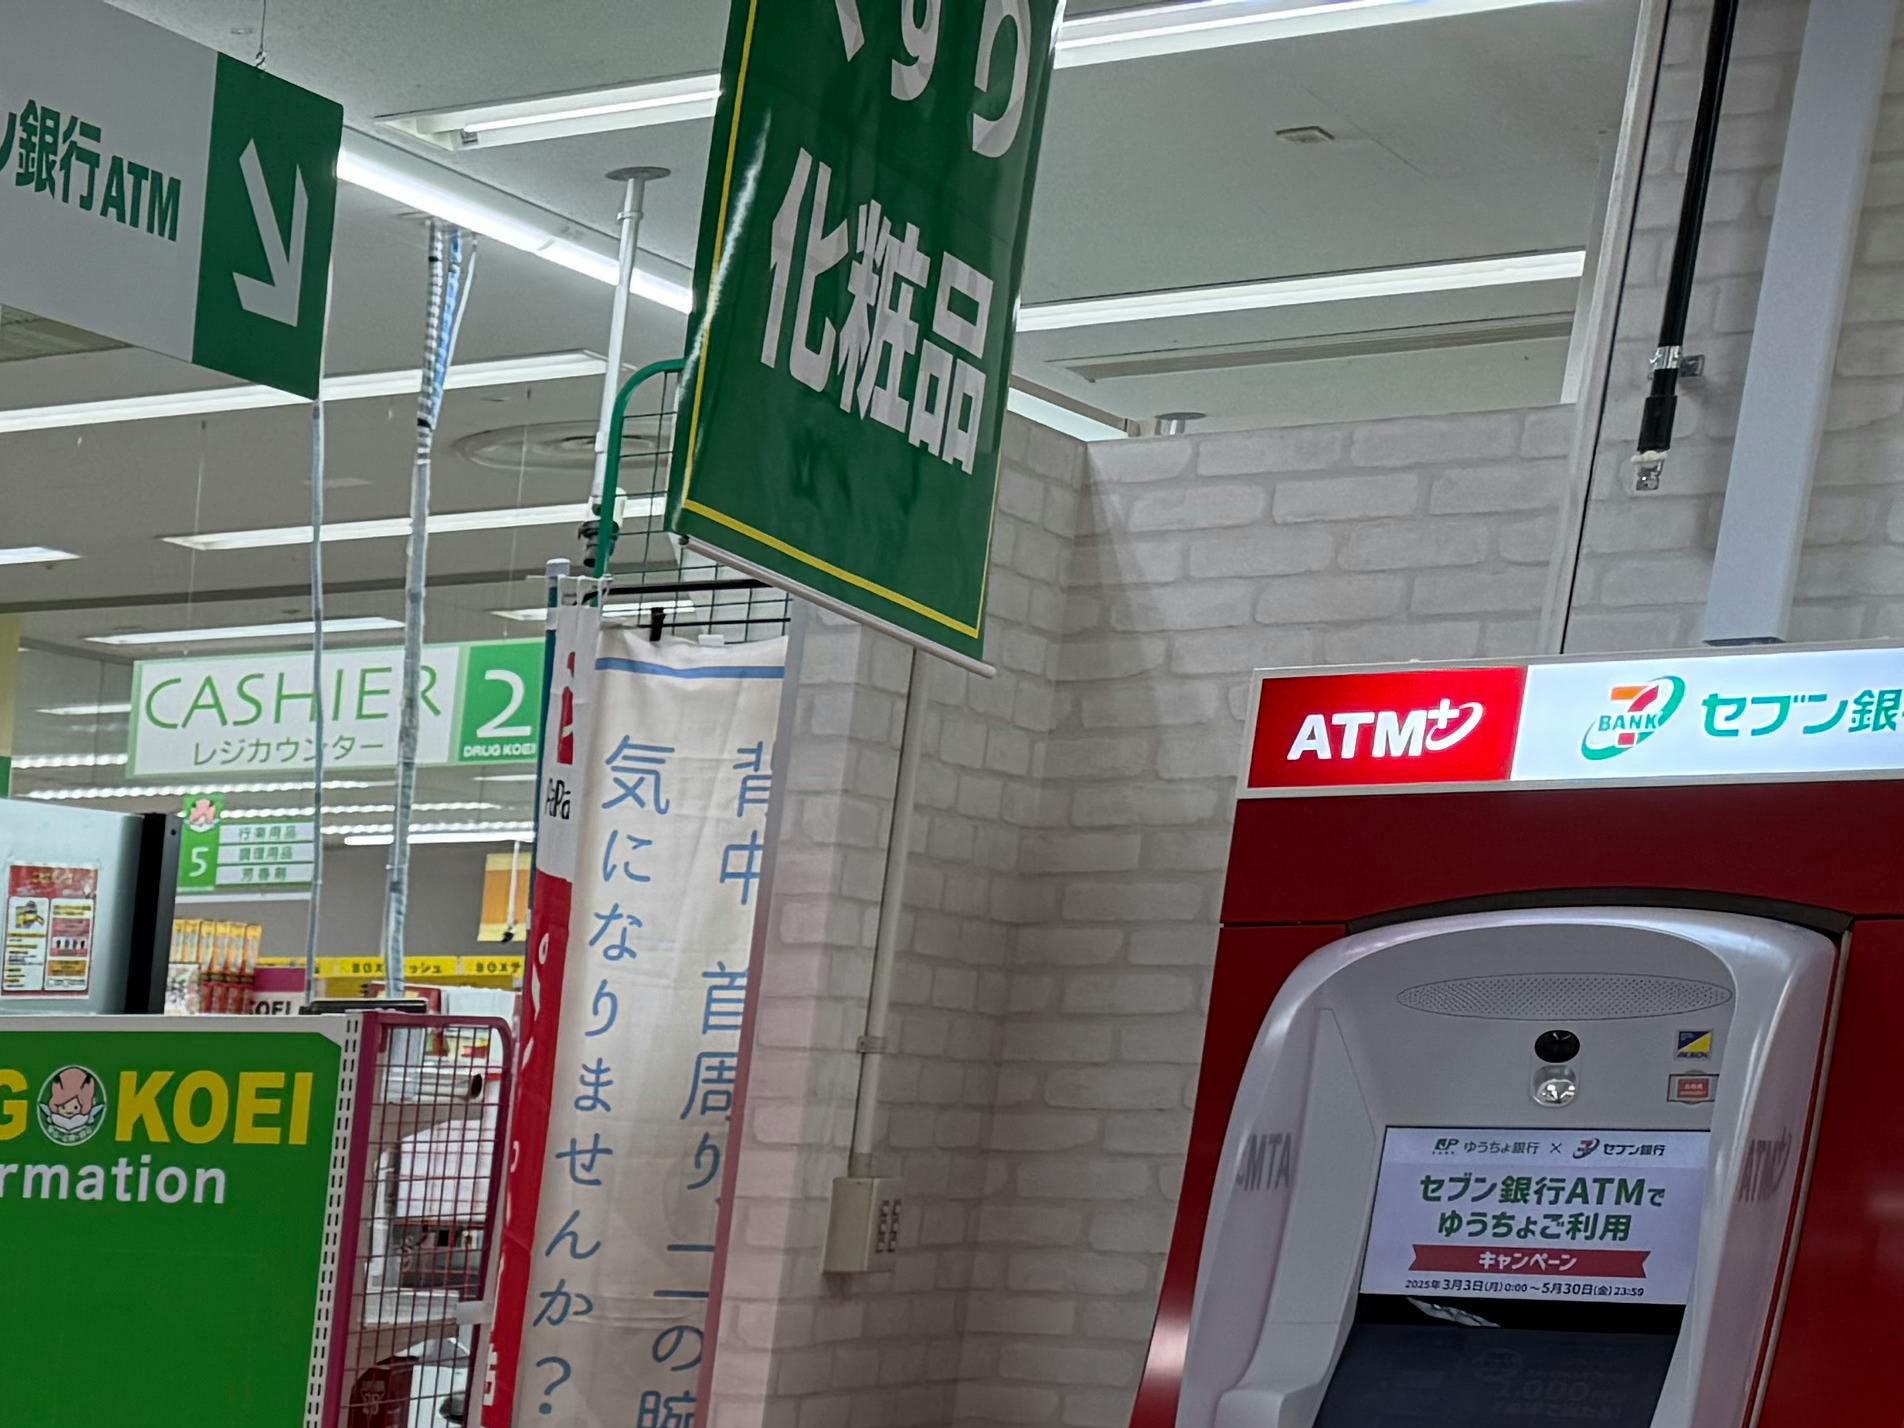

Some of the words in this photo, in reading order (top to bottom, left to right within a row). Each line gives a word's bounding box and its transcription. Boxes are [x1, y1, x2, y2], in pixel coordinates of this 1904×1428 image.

[761, 147, 994, 475] 化粧品
[476, 669, 533, 739] 2
[1702, 689, 1904, 737] セブン銀
[1286, 710, 1428, 761] ATM
[1597, 710, 1659, 733] BANK
[189, 846, 209, 878] 5
[115, 1070, 314, 1145] KOEI
[1463, 1140, 1540, 1156] ゆうちょ銀行
[1603, 1142, 1666, 1157] セブン銀行
[1419, 1172, 1666, 1208] セブン銀行ATMで
[1438, 1210, 1633, 1242] ゆうちょご利用
[1478, 1251, 1579, 1271] キャンペーン
